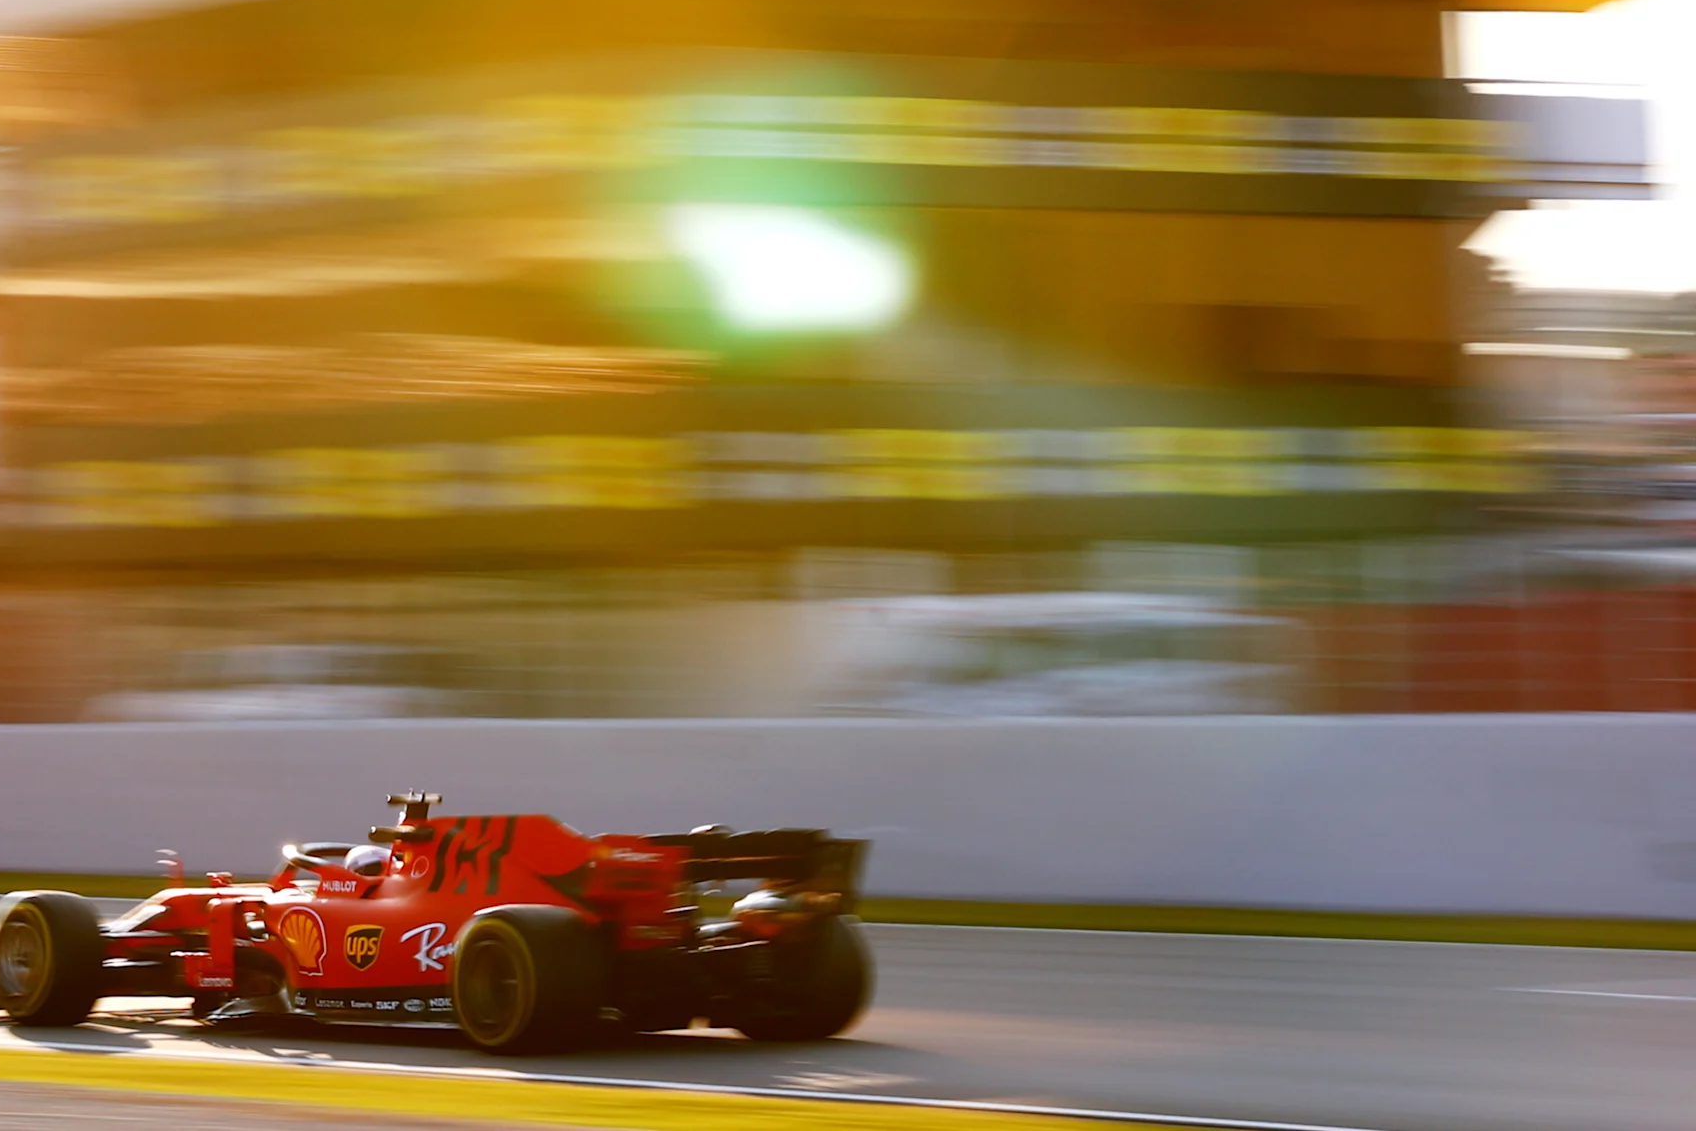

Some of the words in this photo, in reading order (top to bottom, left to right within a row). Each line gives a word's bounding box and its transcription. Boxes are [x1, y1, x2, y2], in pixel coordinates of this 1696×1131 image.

[322, 880, 357, 892] HUBLOT
[346, 936, 378, 963] ups
[376, 1001, 400, 1010] SKF
